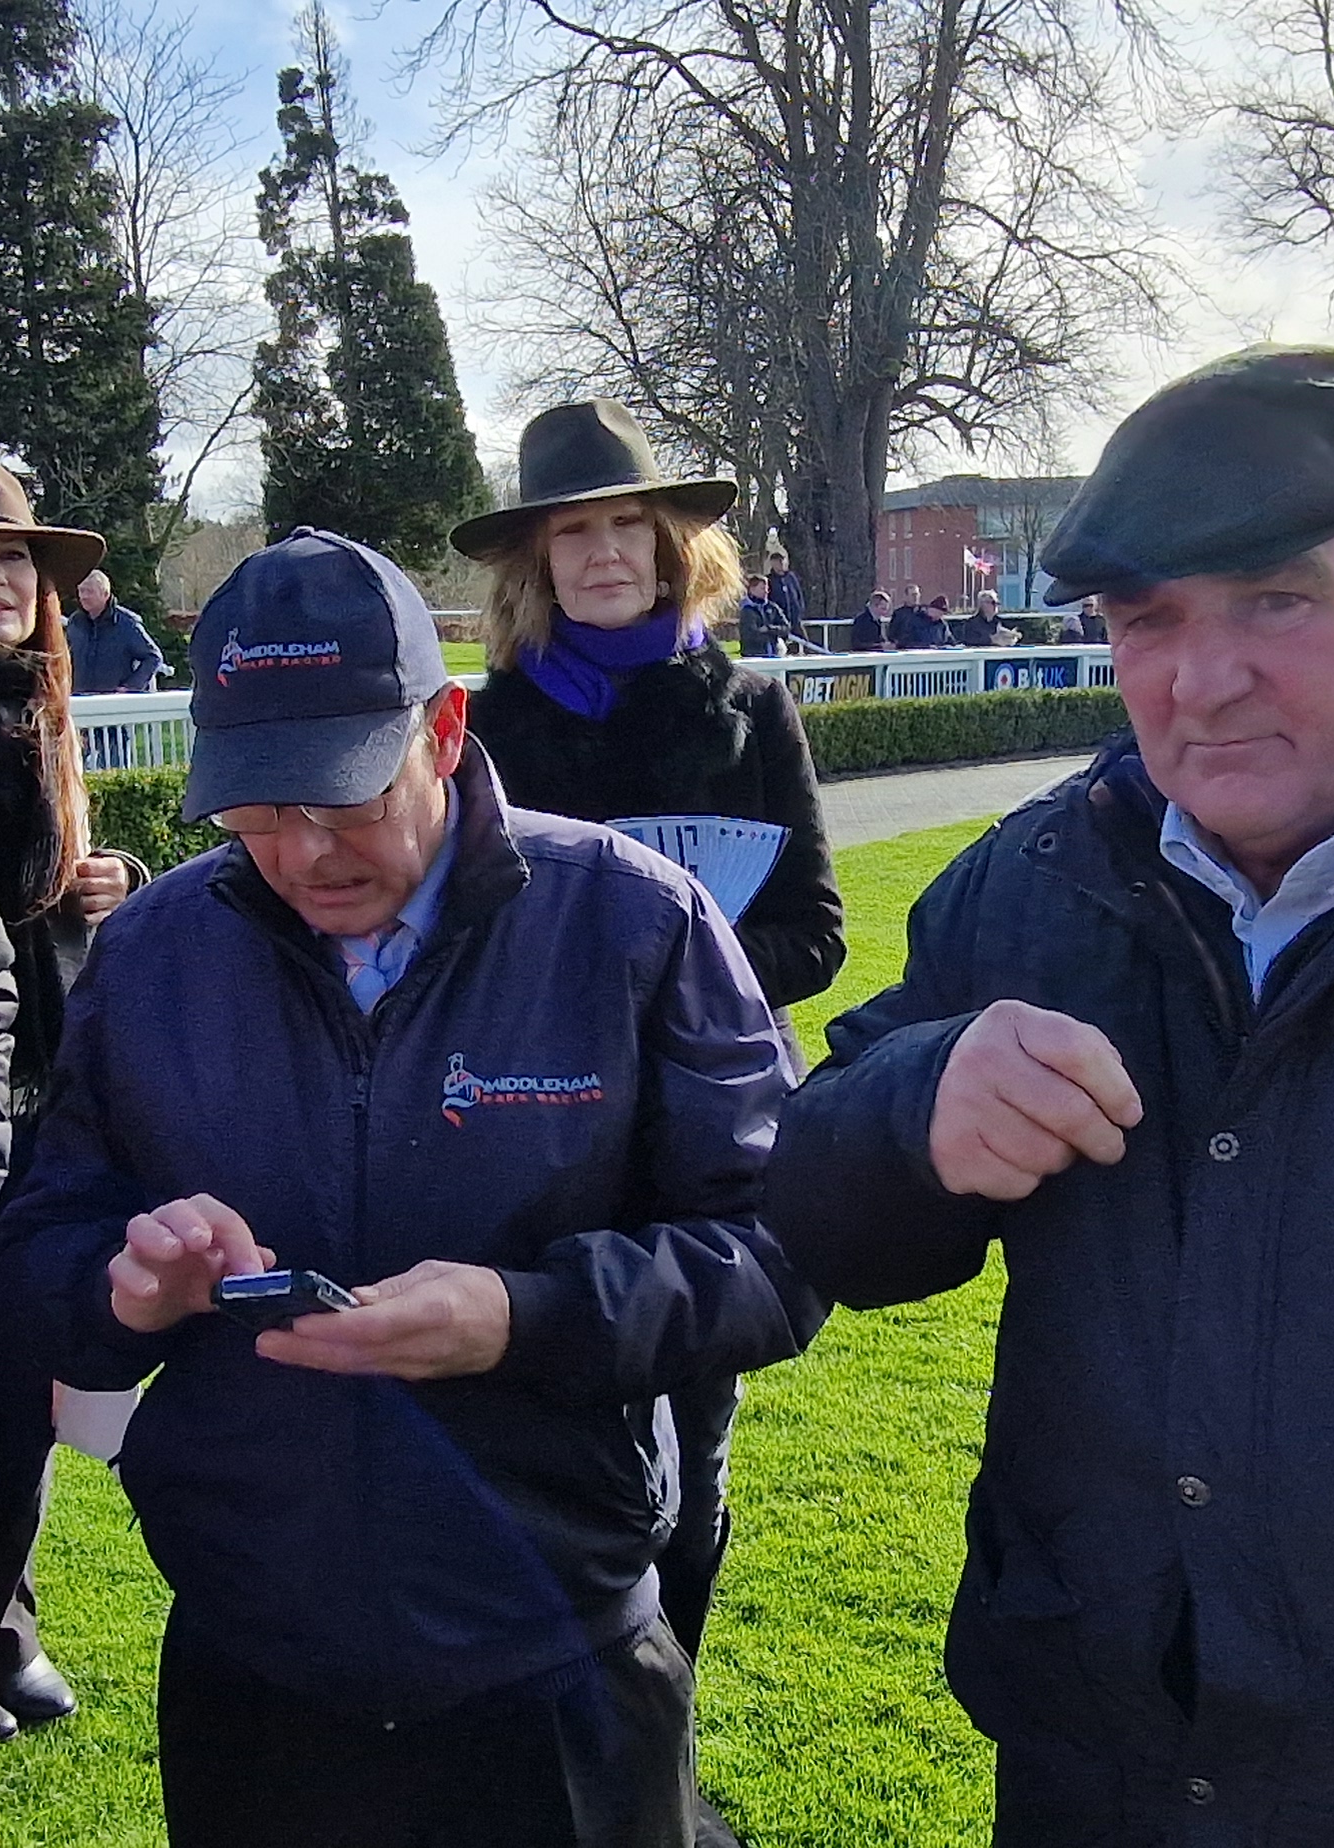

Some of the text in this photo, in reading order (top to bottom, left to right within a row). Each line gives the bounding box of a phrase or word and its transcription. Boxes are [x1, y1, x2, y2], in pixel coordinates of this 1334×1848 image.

[242, 641, 340, 659] MIDDLEHAM
[1018, 666, 1066, 689] BtUK
[482, 1072, 602, 1093] MIDDLEHAM
